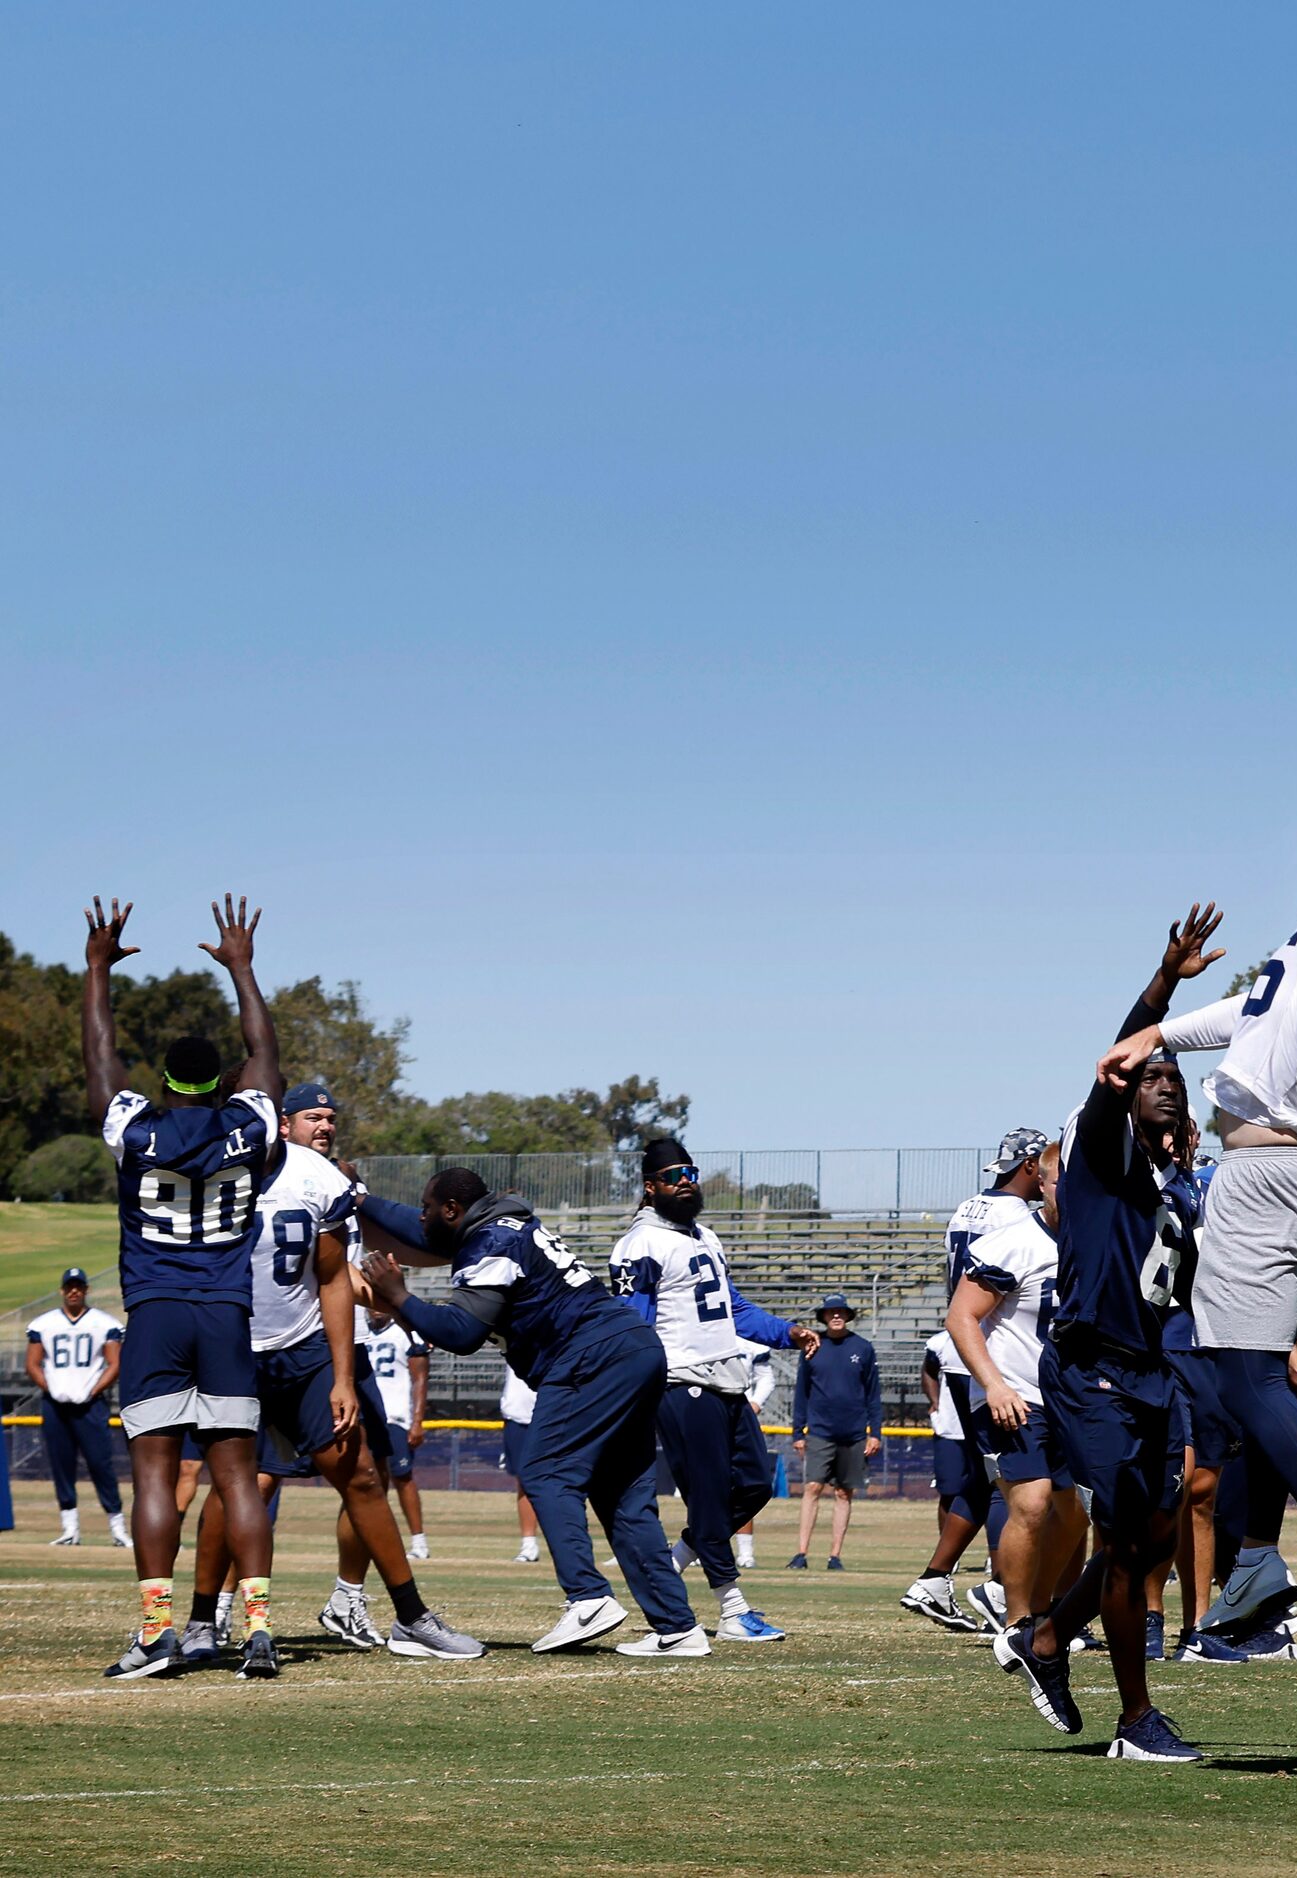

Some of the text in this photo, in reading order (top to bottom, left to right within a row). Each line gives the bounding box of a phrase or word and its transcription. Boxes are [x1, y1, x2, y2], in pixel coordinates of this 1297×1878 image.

[138, 1168, 252, 1244] 90
[688, 1252, 729, 1324] 2
[1140, 1204, 1182, 1307] 6
[52, 1332, 93, 1368] 60
[366, 1342, 396, 1378] 2
